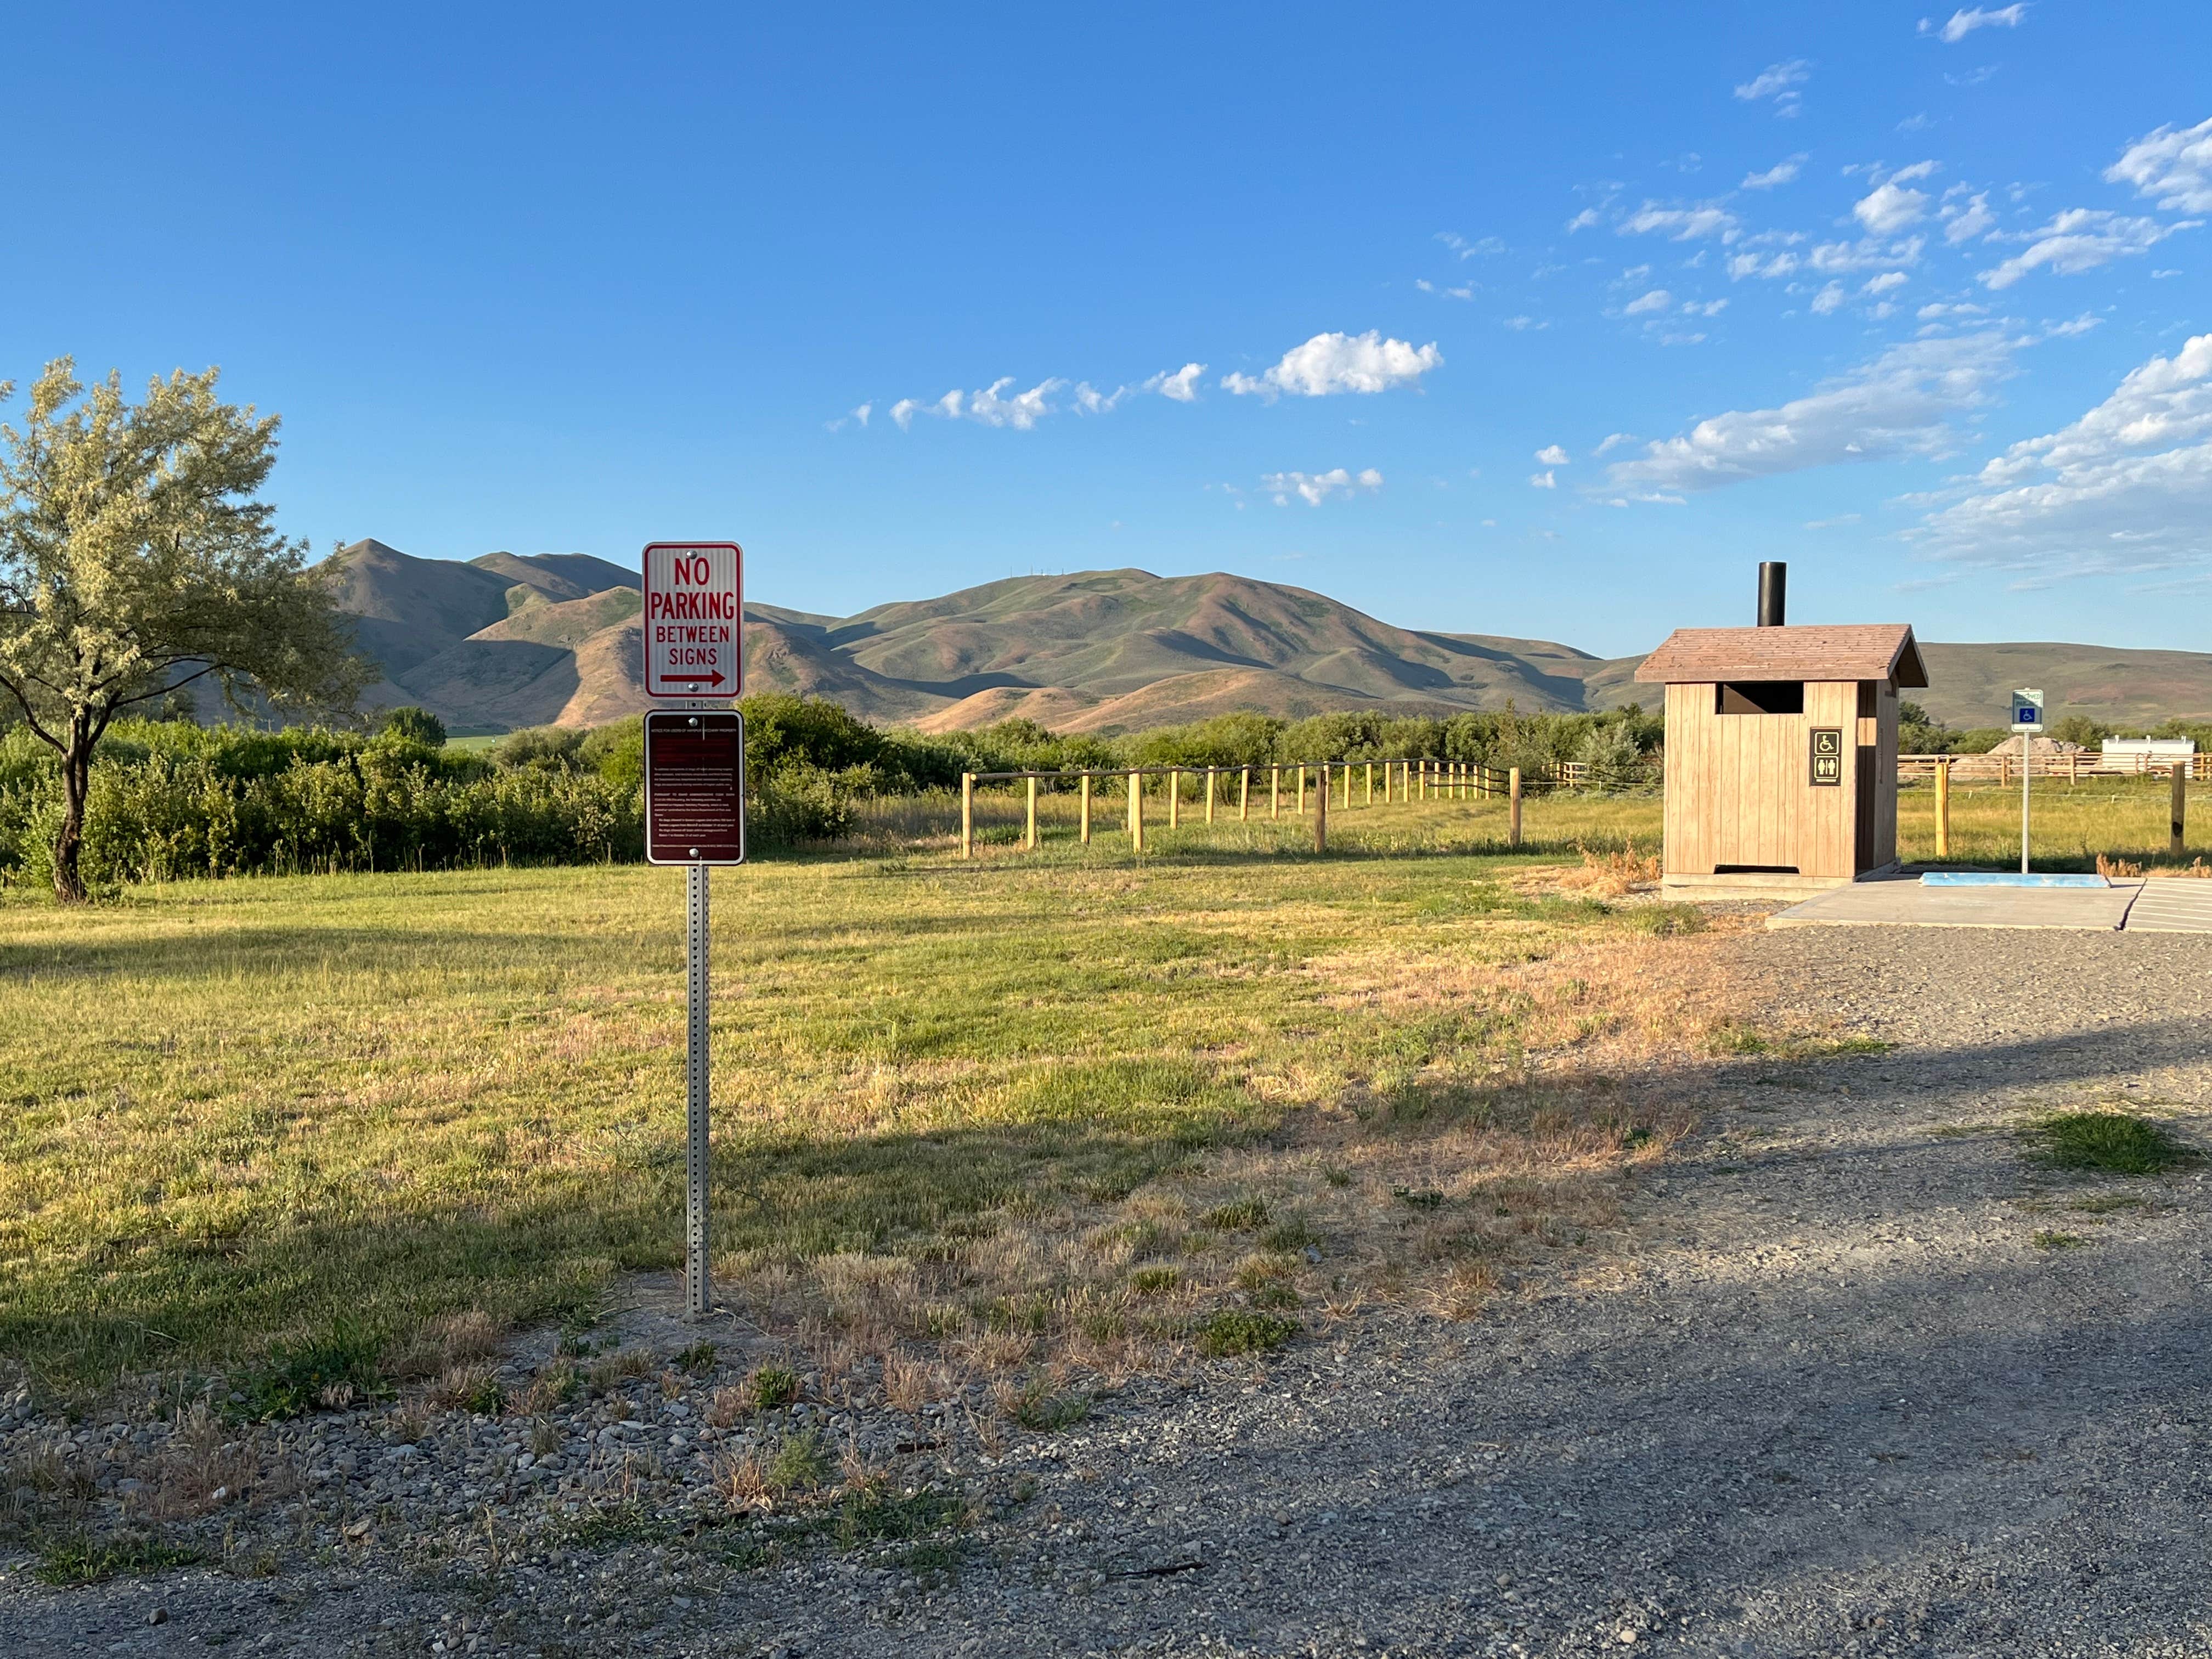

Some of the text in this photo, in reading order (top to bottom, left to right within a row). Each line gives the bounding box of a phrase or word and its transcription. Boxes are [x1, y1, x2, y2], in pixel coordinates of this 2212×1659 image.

[675, 557, 710, 585] NO
[651, 592, 735, 620] PARKING
[656, 626, 729, 642] BETWEEN
[669, 648, 717, 665] SIGNS
